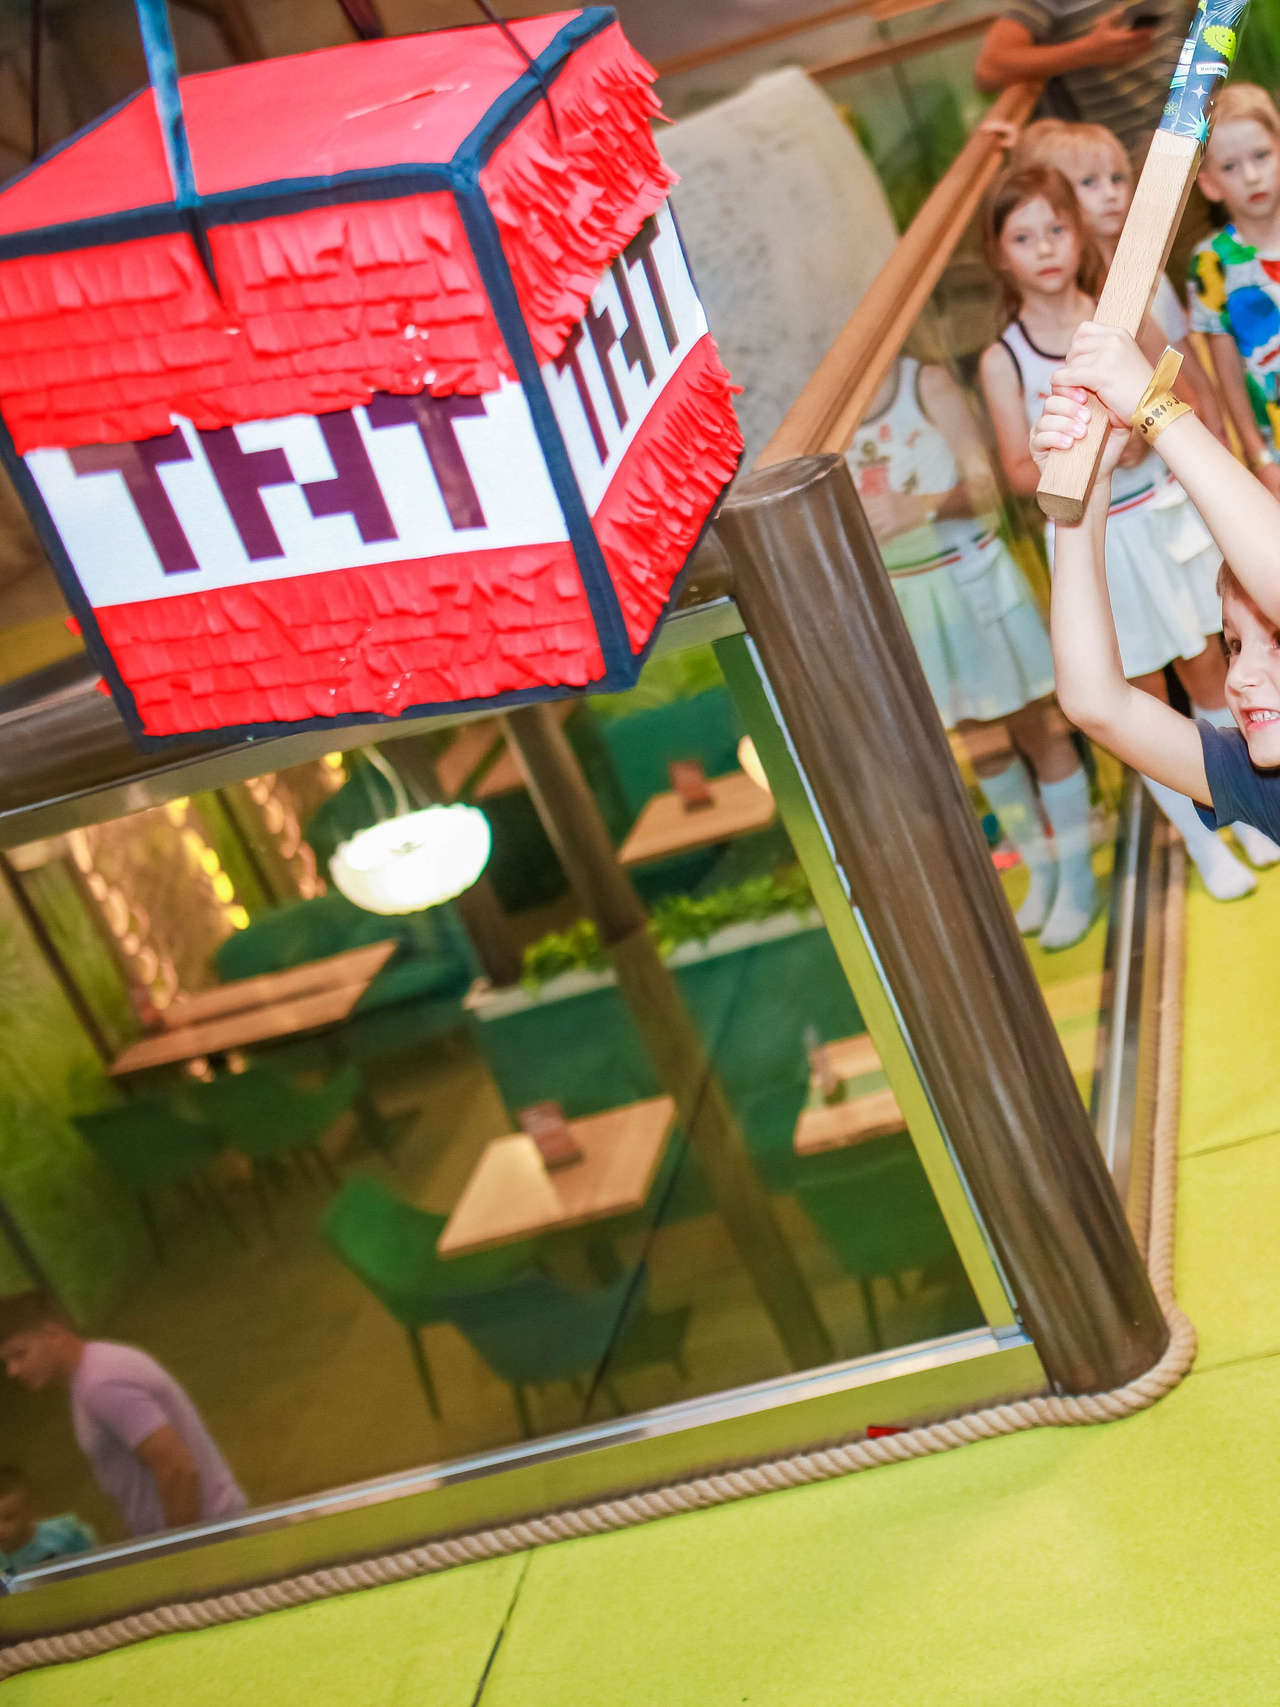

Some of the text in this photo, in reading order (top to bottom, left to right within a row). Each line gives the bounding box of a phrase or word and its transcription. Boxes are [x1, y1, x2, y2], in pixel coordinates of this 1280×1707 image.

[554, 214, 681, 468] TNT
[1140, 404, 1168, 435] JOKI
[66, 386, 489, 577] TNT
